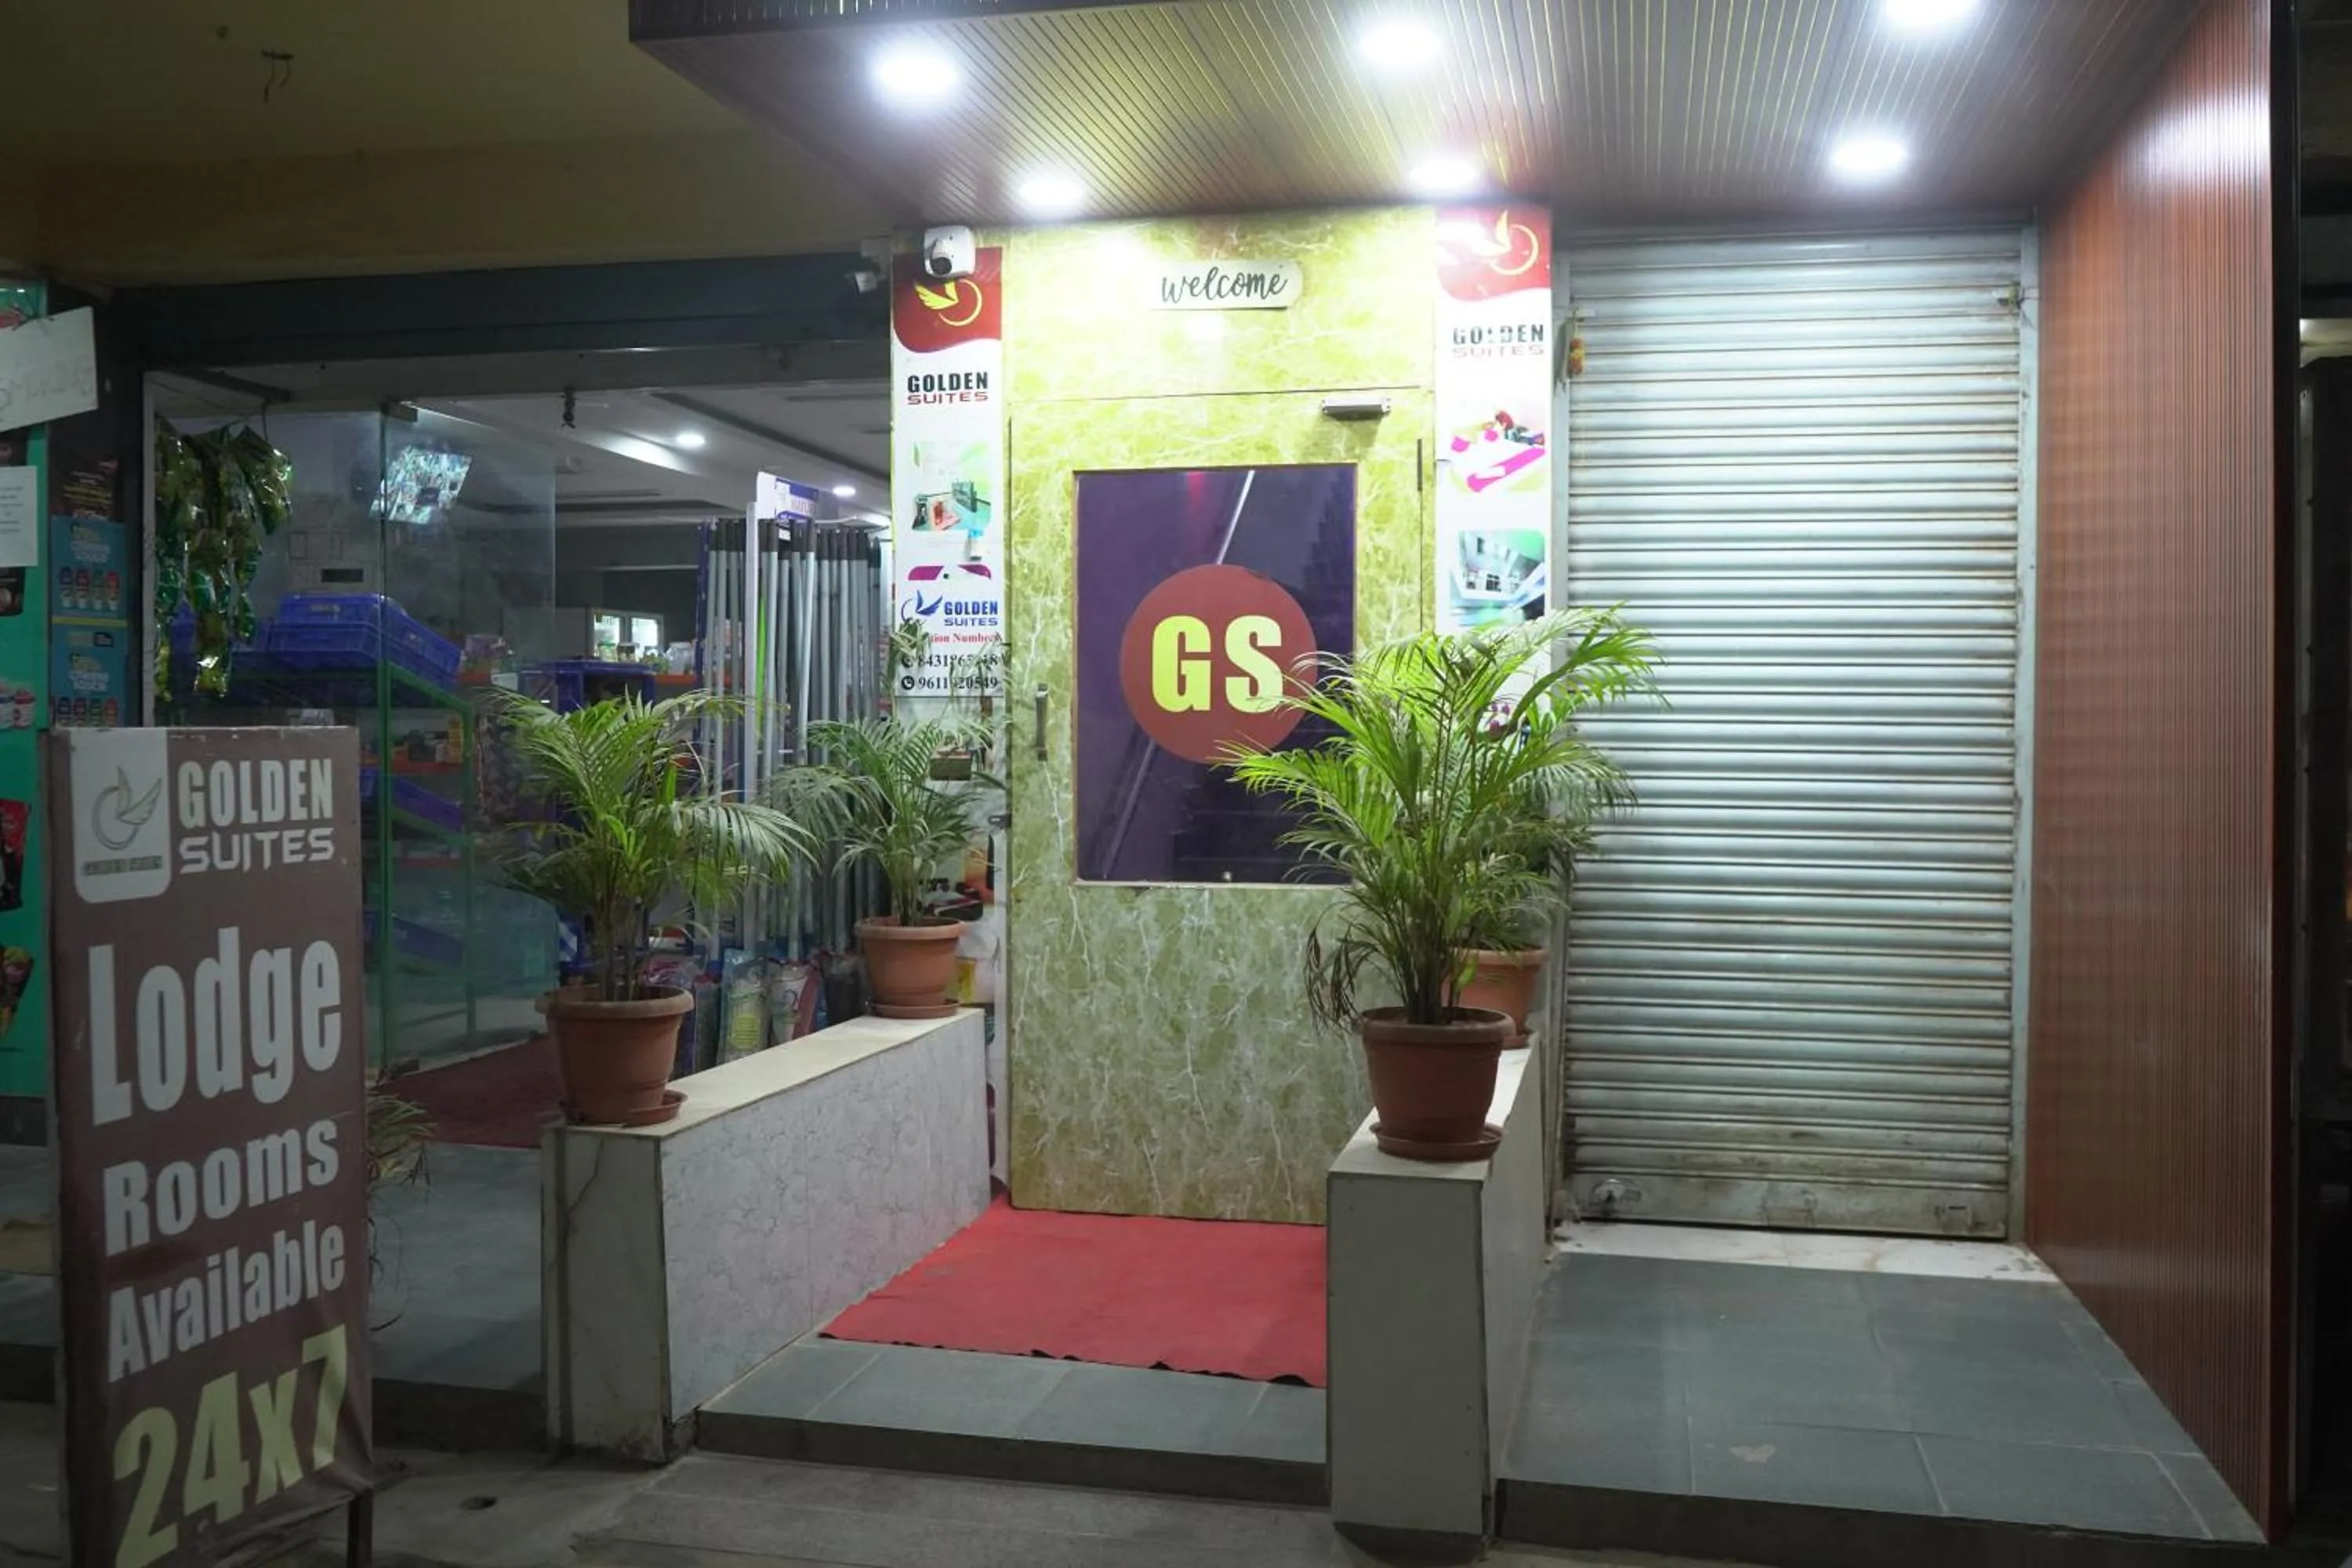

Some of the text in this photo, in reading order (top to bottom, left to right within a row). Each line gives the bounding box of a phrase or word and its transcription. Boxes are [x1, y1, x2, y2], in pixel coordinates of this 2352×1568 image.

[1161, 267, 1287, 303] welcome
[907, 372, 988, 393] GOLDEN
[907, 392, 988, 405] SUITES
[944, 601, 998, 615] GOLDEN
[944, 617, 998, 626] SUITES
[1152, 615, 1283, 712] GS
[178, 758, 333, 829] GOLDEN
[180, 827, 335, 874] SUITES
[88, 927, 341, 1126] Lodge
[103, 1119, 339, 1255] Rooms
[108, 1220, 346, 1382] Available
